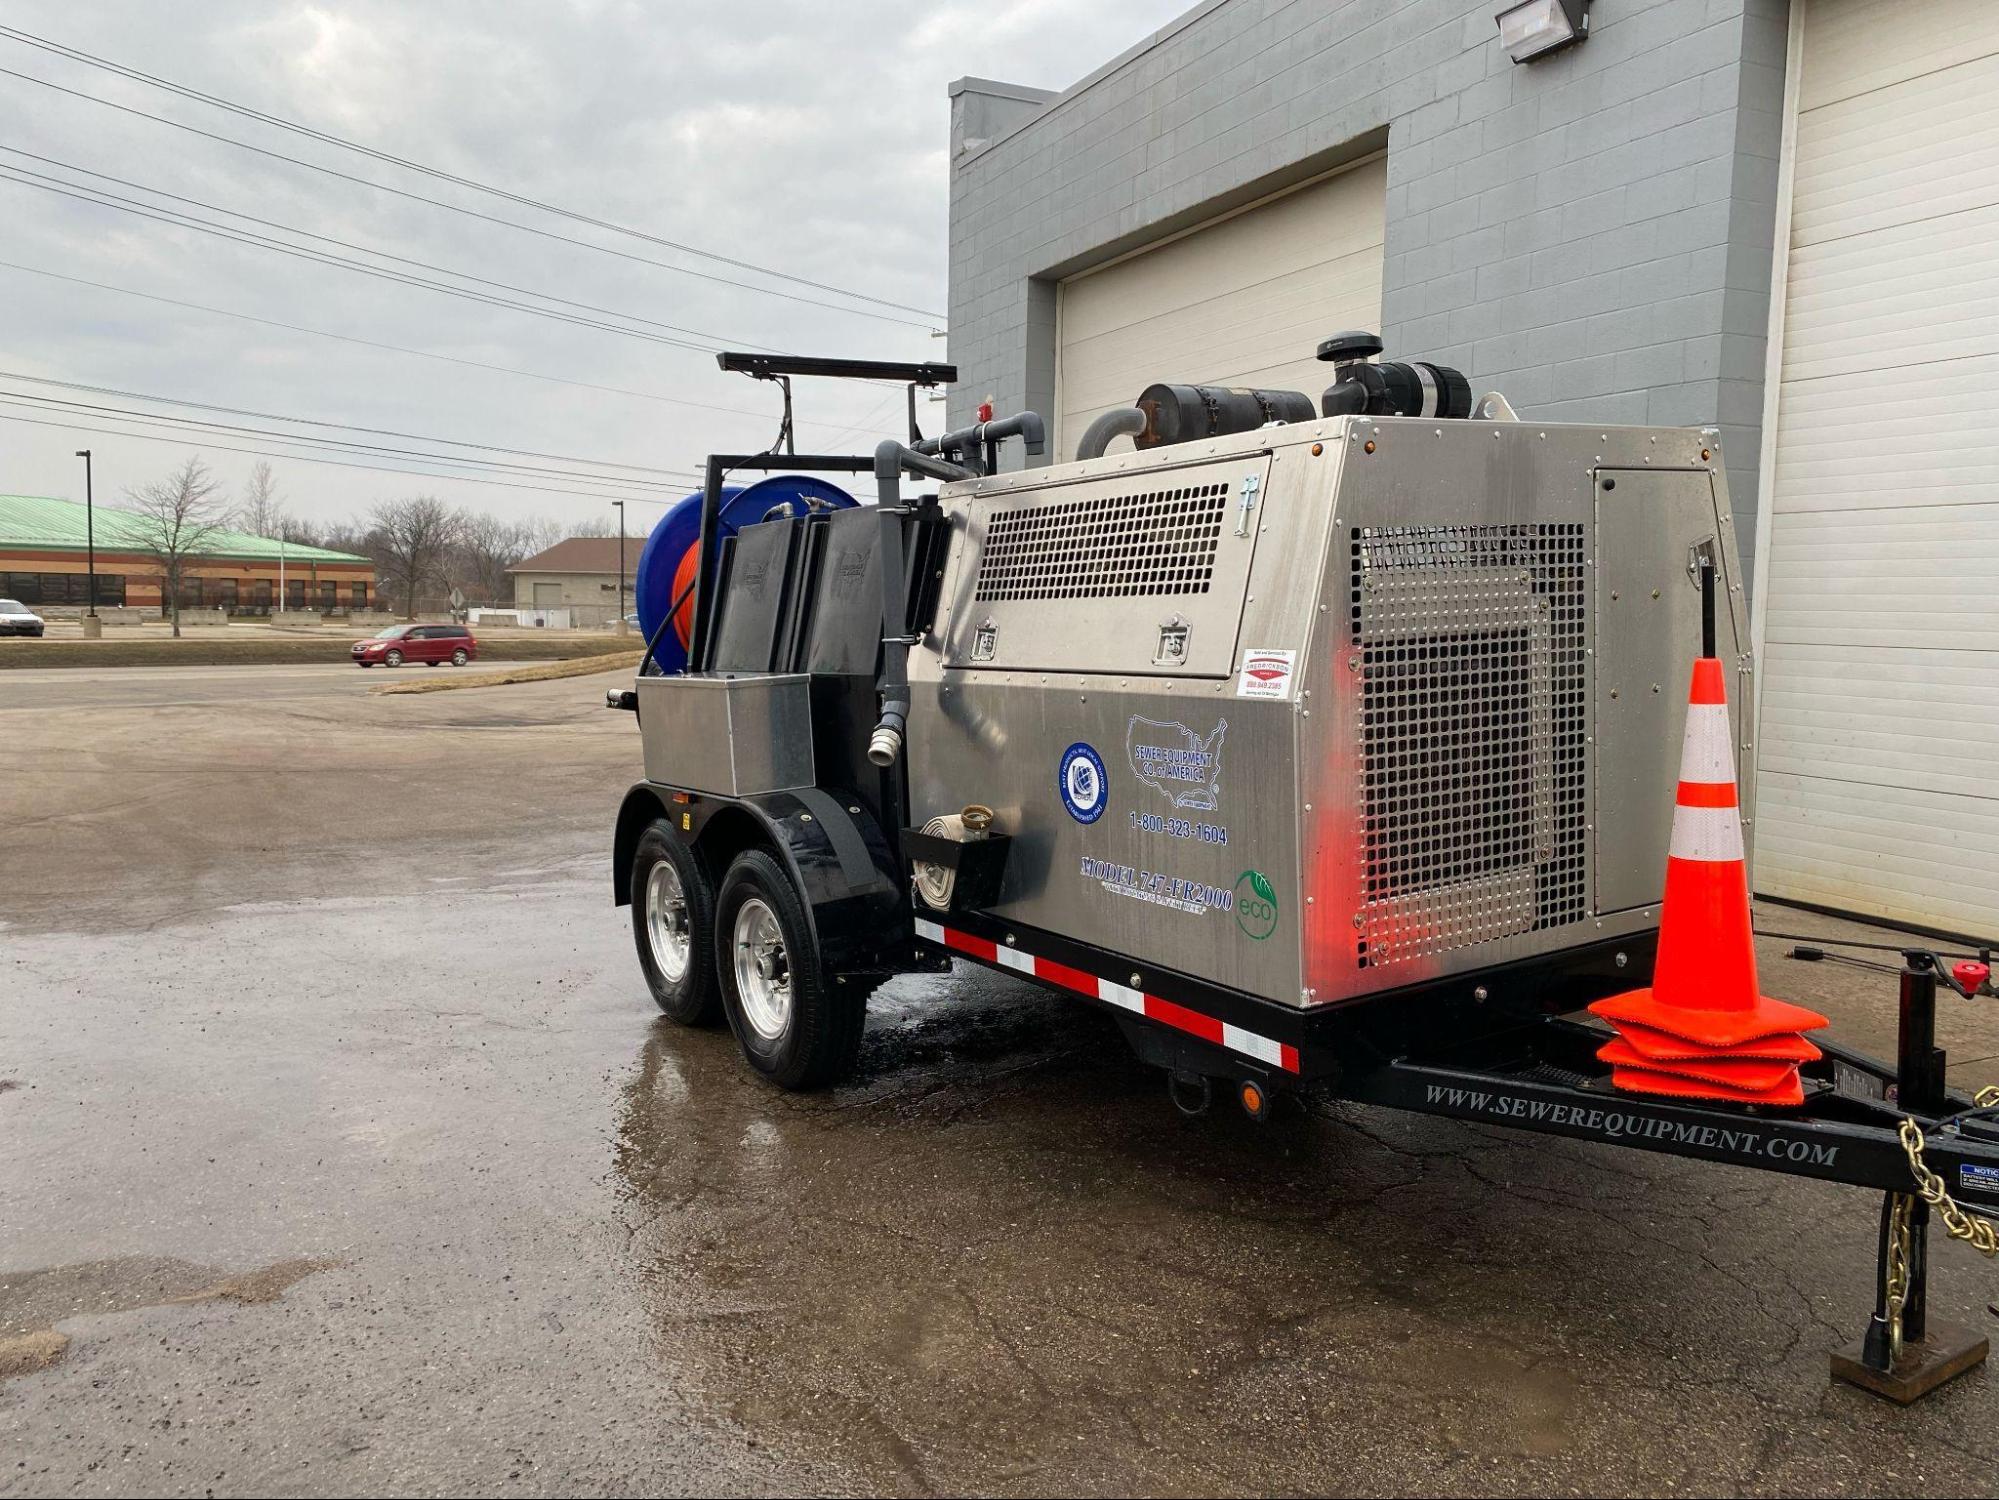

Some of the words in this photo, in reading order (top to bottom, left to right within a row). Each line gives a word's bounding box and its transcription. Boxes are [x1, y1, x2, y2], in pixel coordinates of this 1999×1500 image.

[1135, 745, 1162, 761] SEWER
[1163, 747, 1212, 767] EQUIPMENT
[1143, 761, 1156, 776] CO.
[1157, 763, 1166, 778] of
[1166, 764, 1205, 783] AMERICA
[1130, 811, 1228, 846] 1-800-323-1604
[1080, 856, 1138, 888] MODEL
[1141, 871, 1233, 911] 747-FR2000
[1239, 898, 1272, 921] eco
[1425, 1084, 1840, 1168] WWW.SEWEREQUIPMENT.COM
